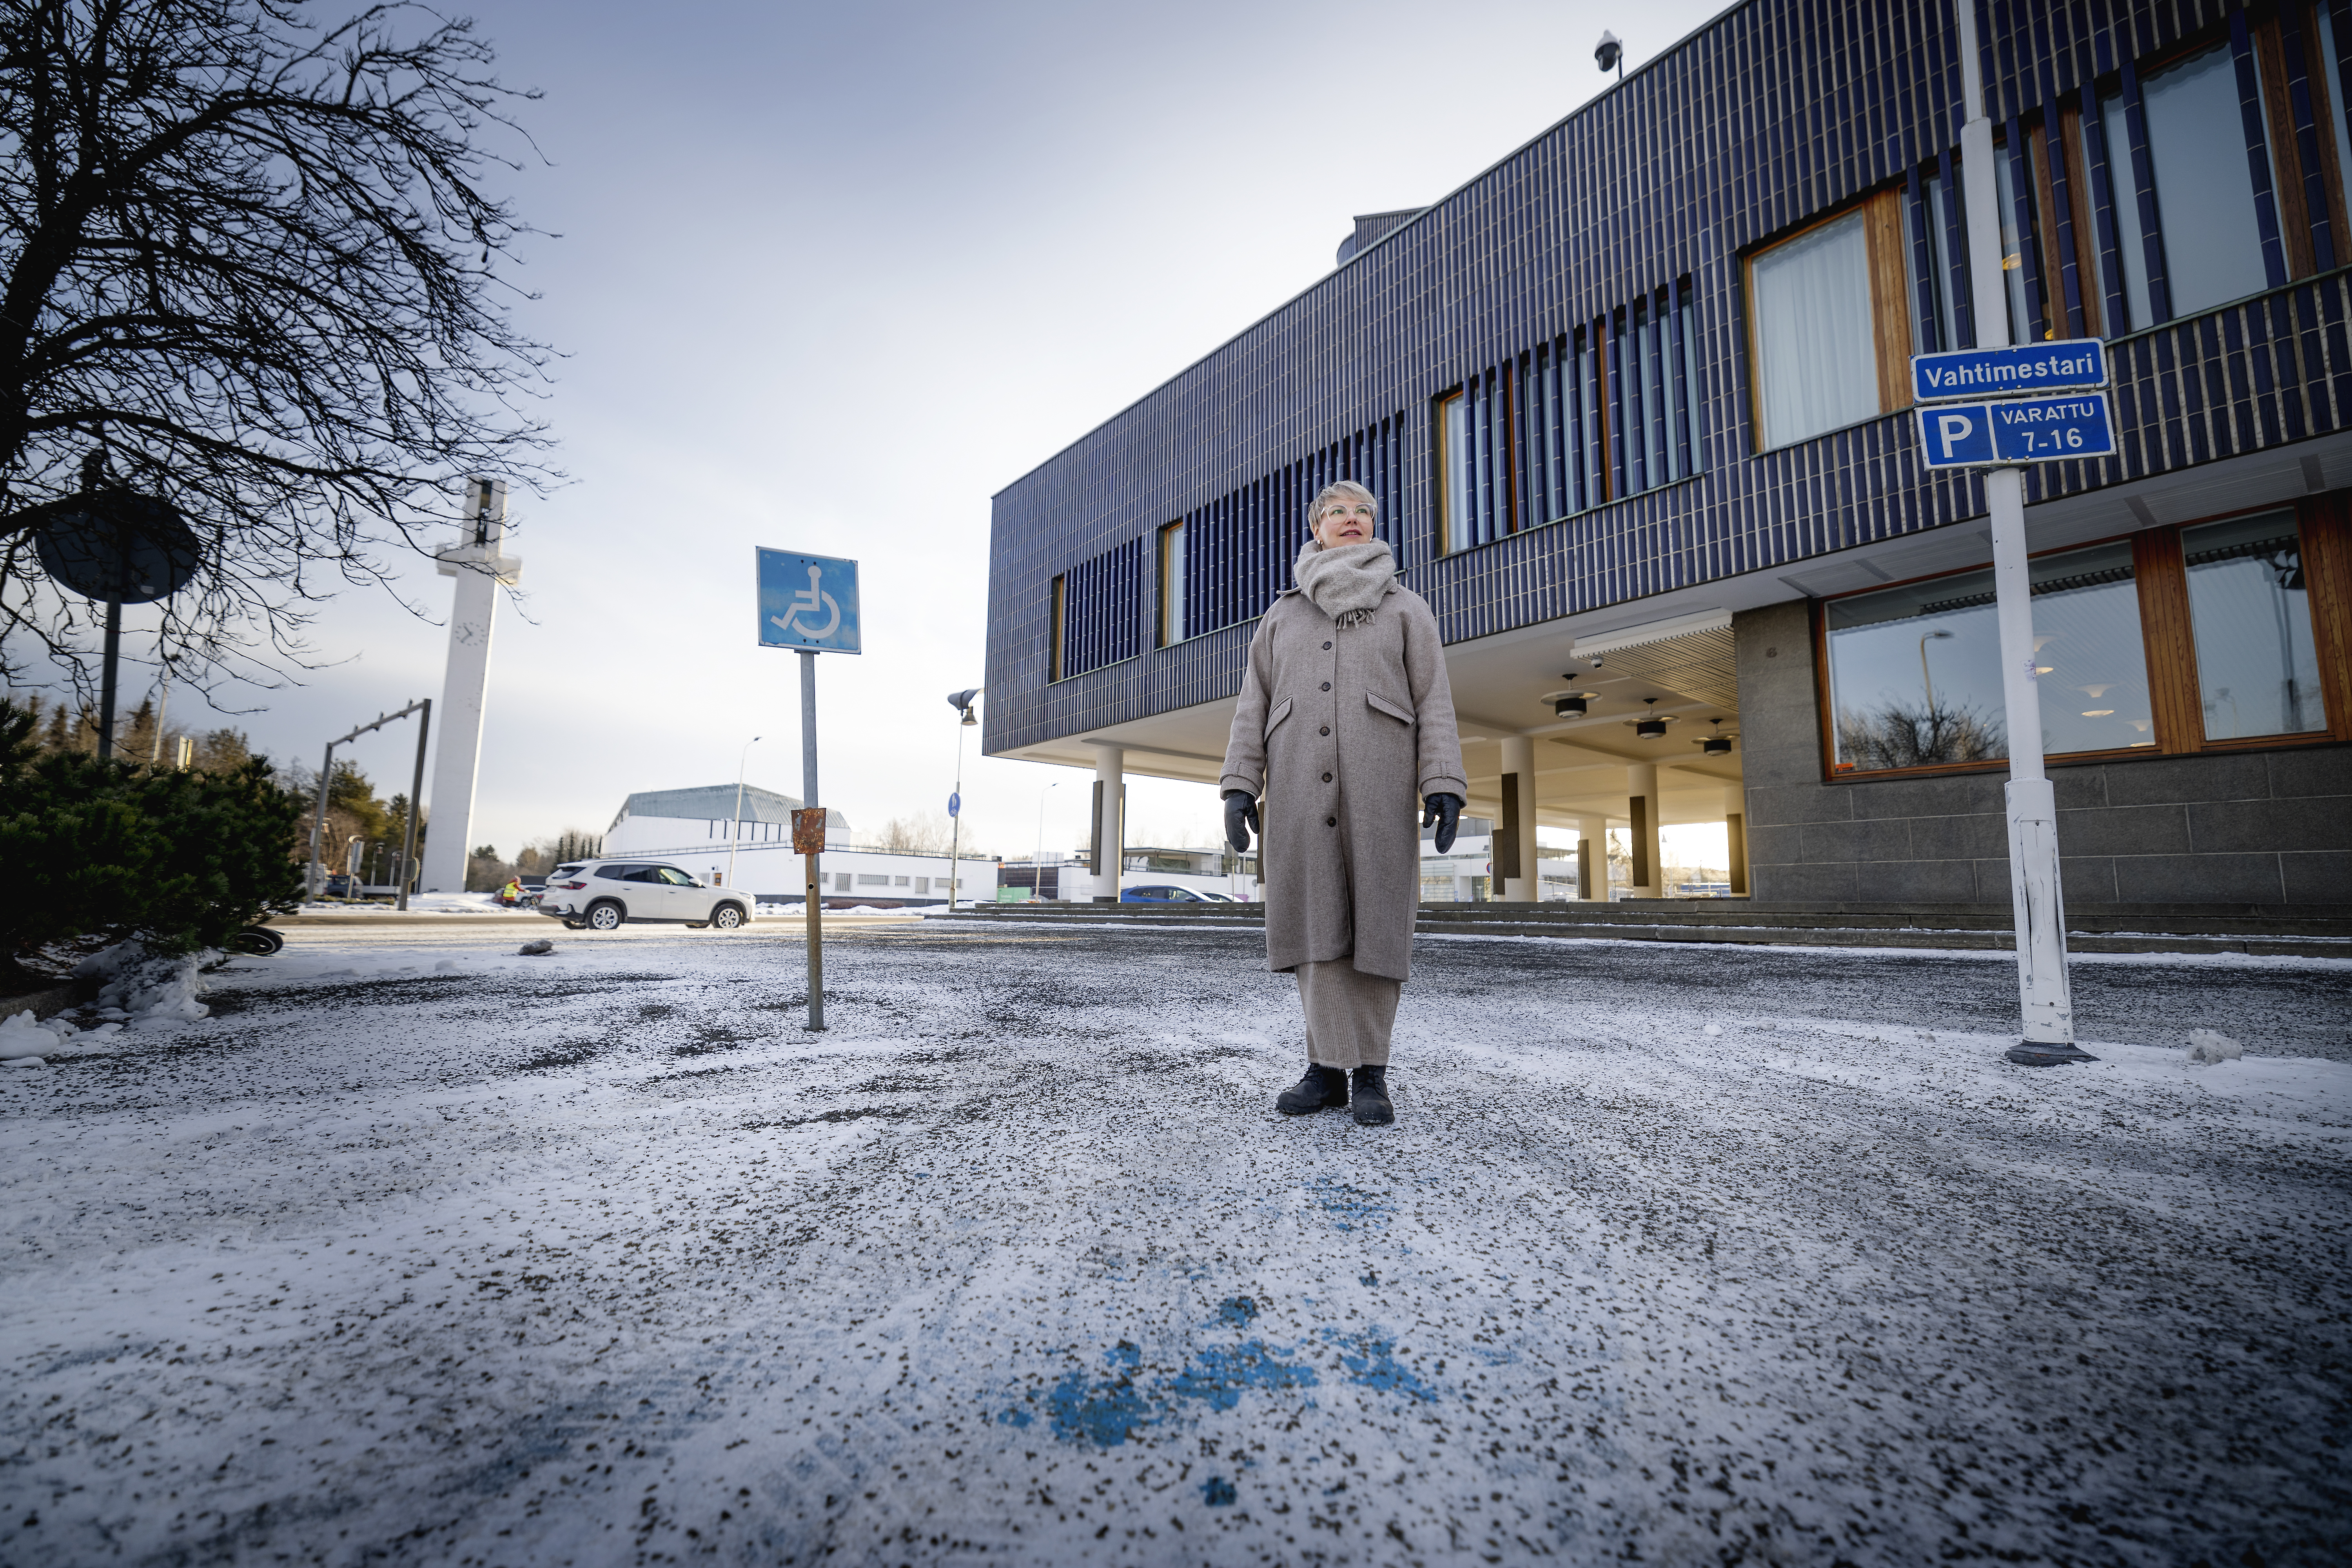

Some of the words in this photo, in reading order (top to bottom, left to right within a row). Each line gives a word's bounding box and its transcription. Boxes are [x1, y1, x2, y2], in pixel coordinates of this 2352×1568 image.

[1925, 353, 2094, 388] Vahtimestari
[2000, 402, 2094, 425] VARATTU
[1938, 414, 1973, 458] P
[2021, 427, 2083, 452] 7-16
[1766, 646, 1777, 658] 6
